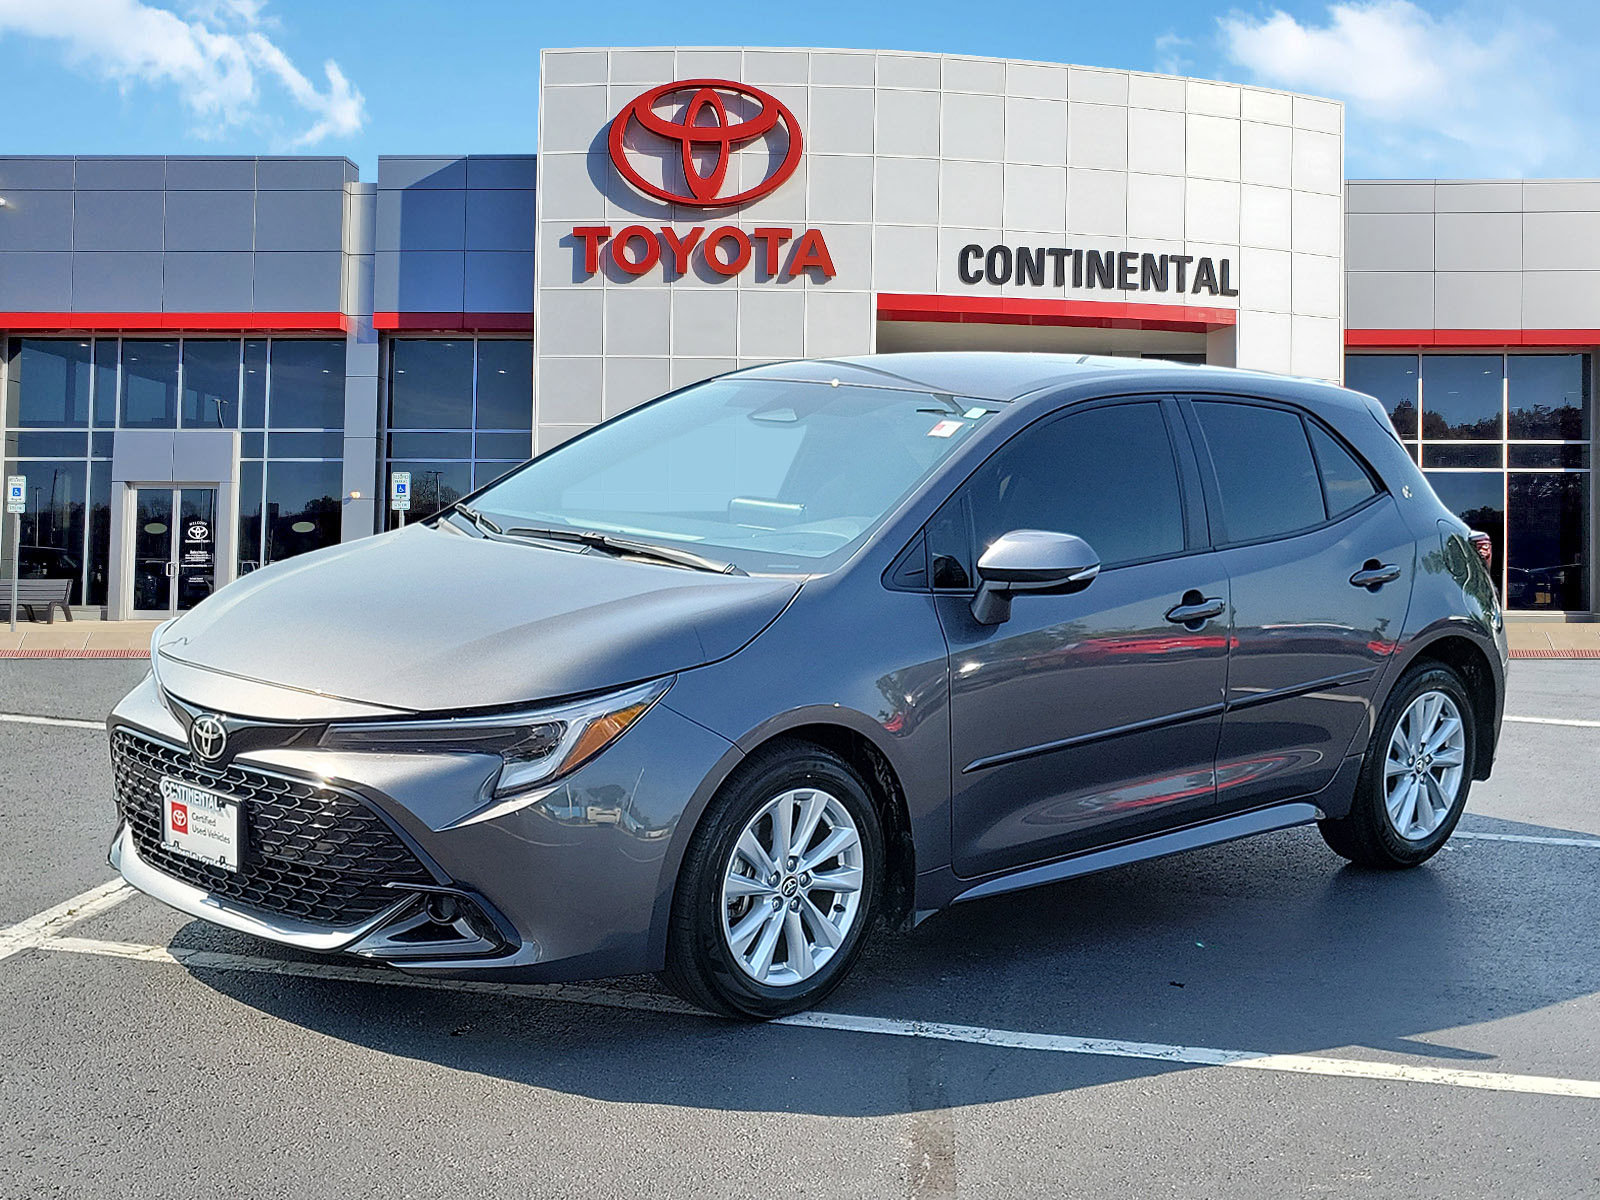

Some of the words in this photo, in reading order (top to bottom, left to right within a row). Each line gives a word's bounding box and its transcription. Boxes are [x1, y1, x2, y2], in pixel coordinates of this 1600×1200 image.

[572, 225, 837, 277] TOYOTA
[958, 244, 1239, 297] CONTINENTAL
[191, 811, 217, 828] Certified
[191, 823, 207, 837] Used
[207, 828, 231, 844] Vehicles
